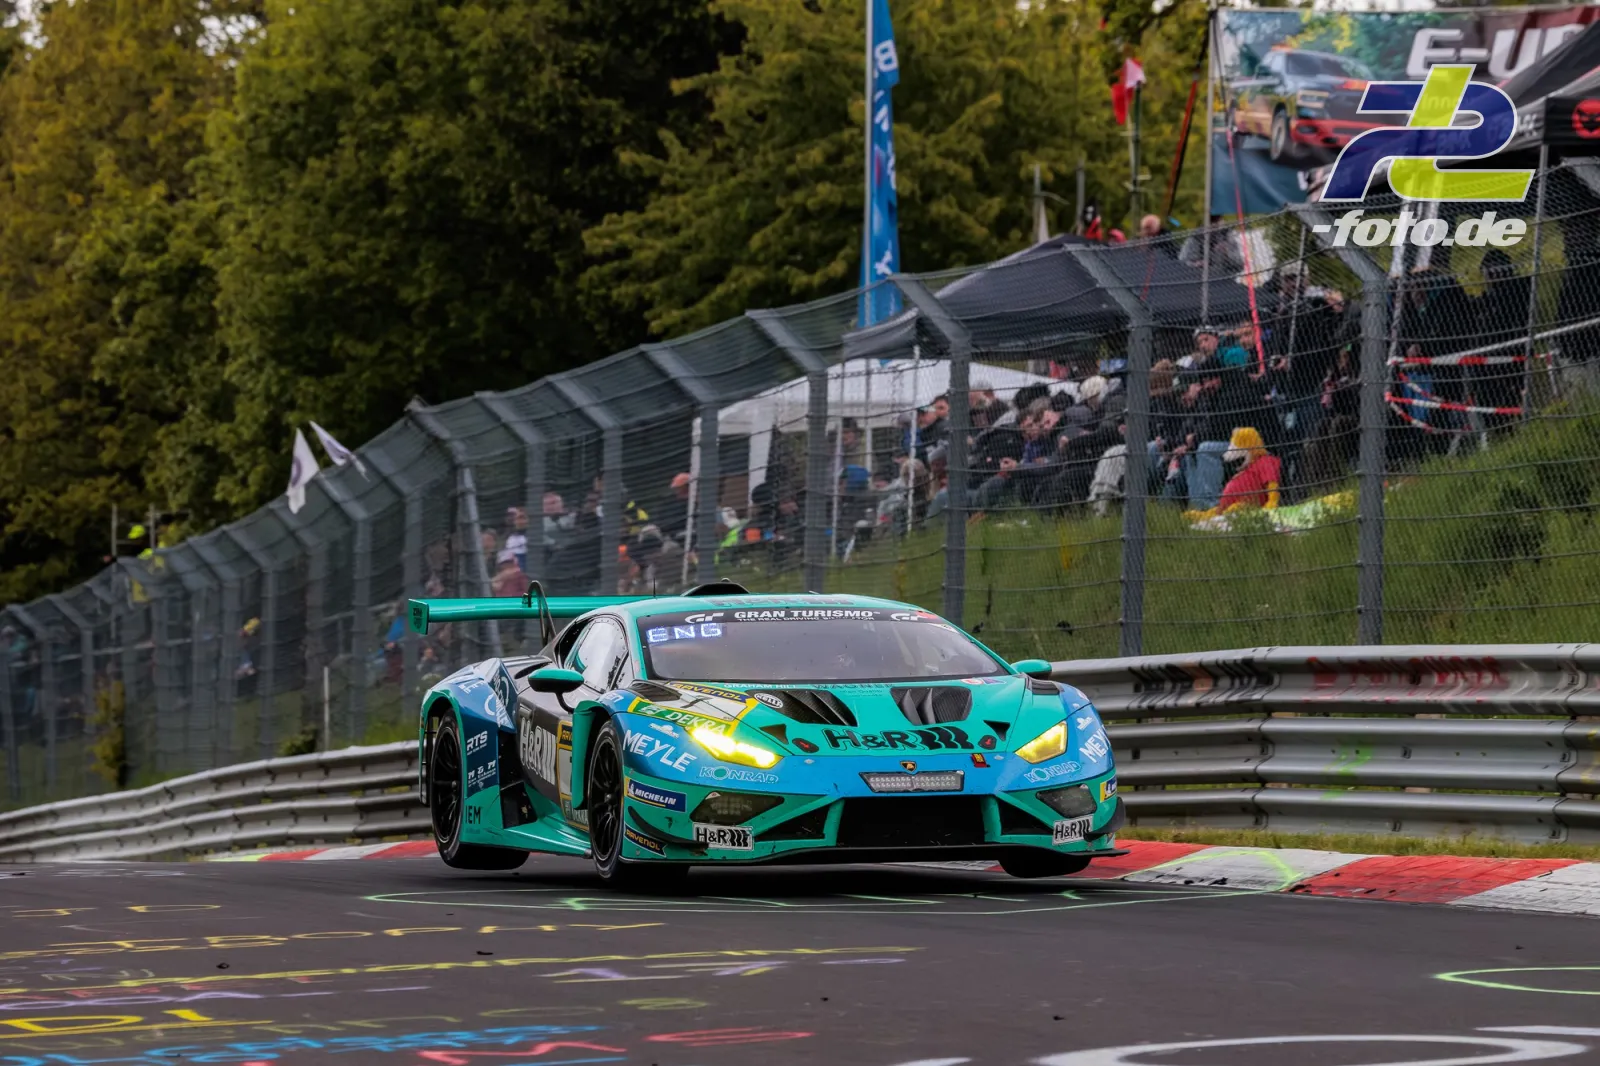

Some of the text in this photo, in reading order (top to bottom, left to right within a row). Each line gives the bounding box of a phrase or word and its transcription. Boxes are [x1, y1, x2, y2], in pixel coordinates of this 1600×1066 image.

[734, 609, 873, 619] GRAN TURISMO
[671, 682, 743, 701] RAVENOL
[665, 711, 726, 736] DEKRA
[466, 730, 488, 752] RTS
[823, 729, 917, 751] H&R
[623, 729, 697, 773] MEYLE
[700, 766, 779, 785] KONRAD
[1023, 761, 1082, 784] KONRAD
[634, 788, 677, 806] MICHELIN
[626, 828, 661, 851] RAVENOL
[696, 827, 728, 844] H&R
[1054, 823, 1078, 841] H&R
